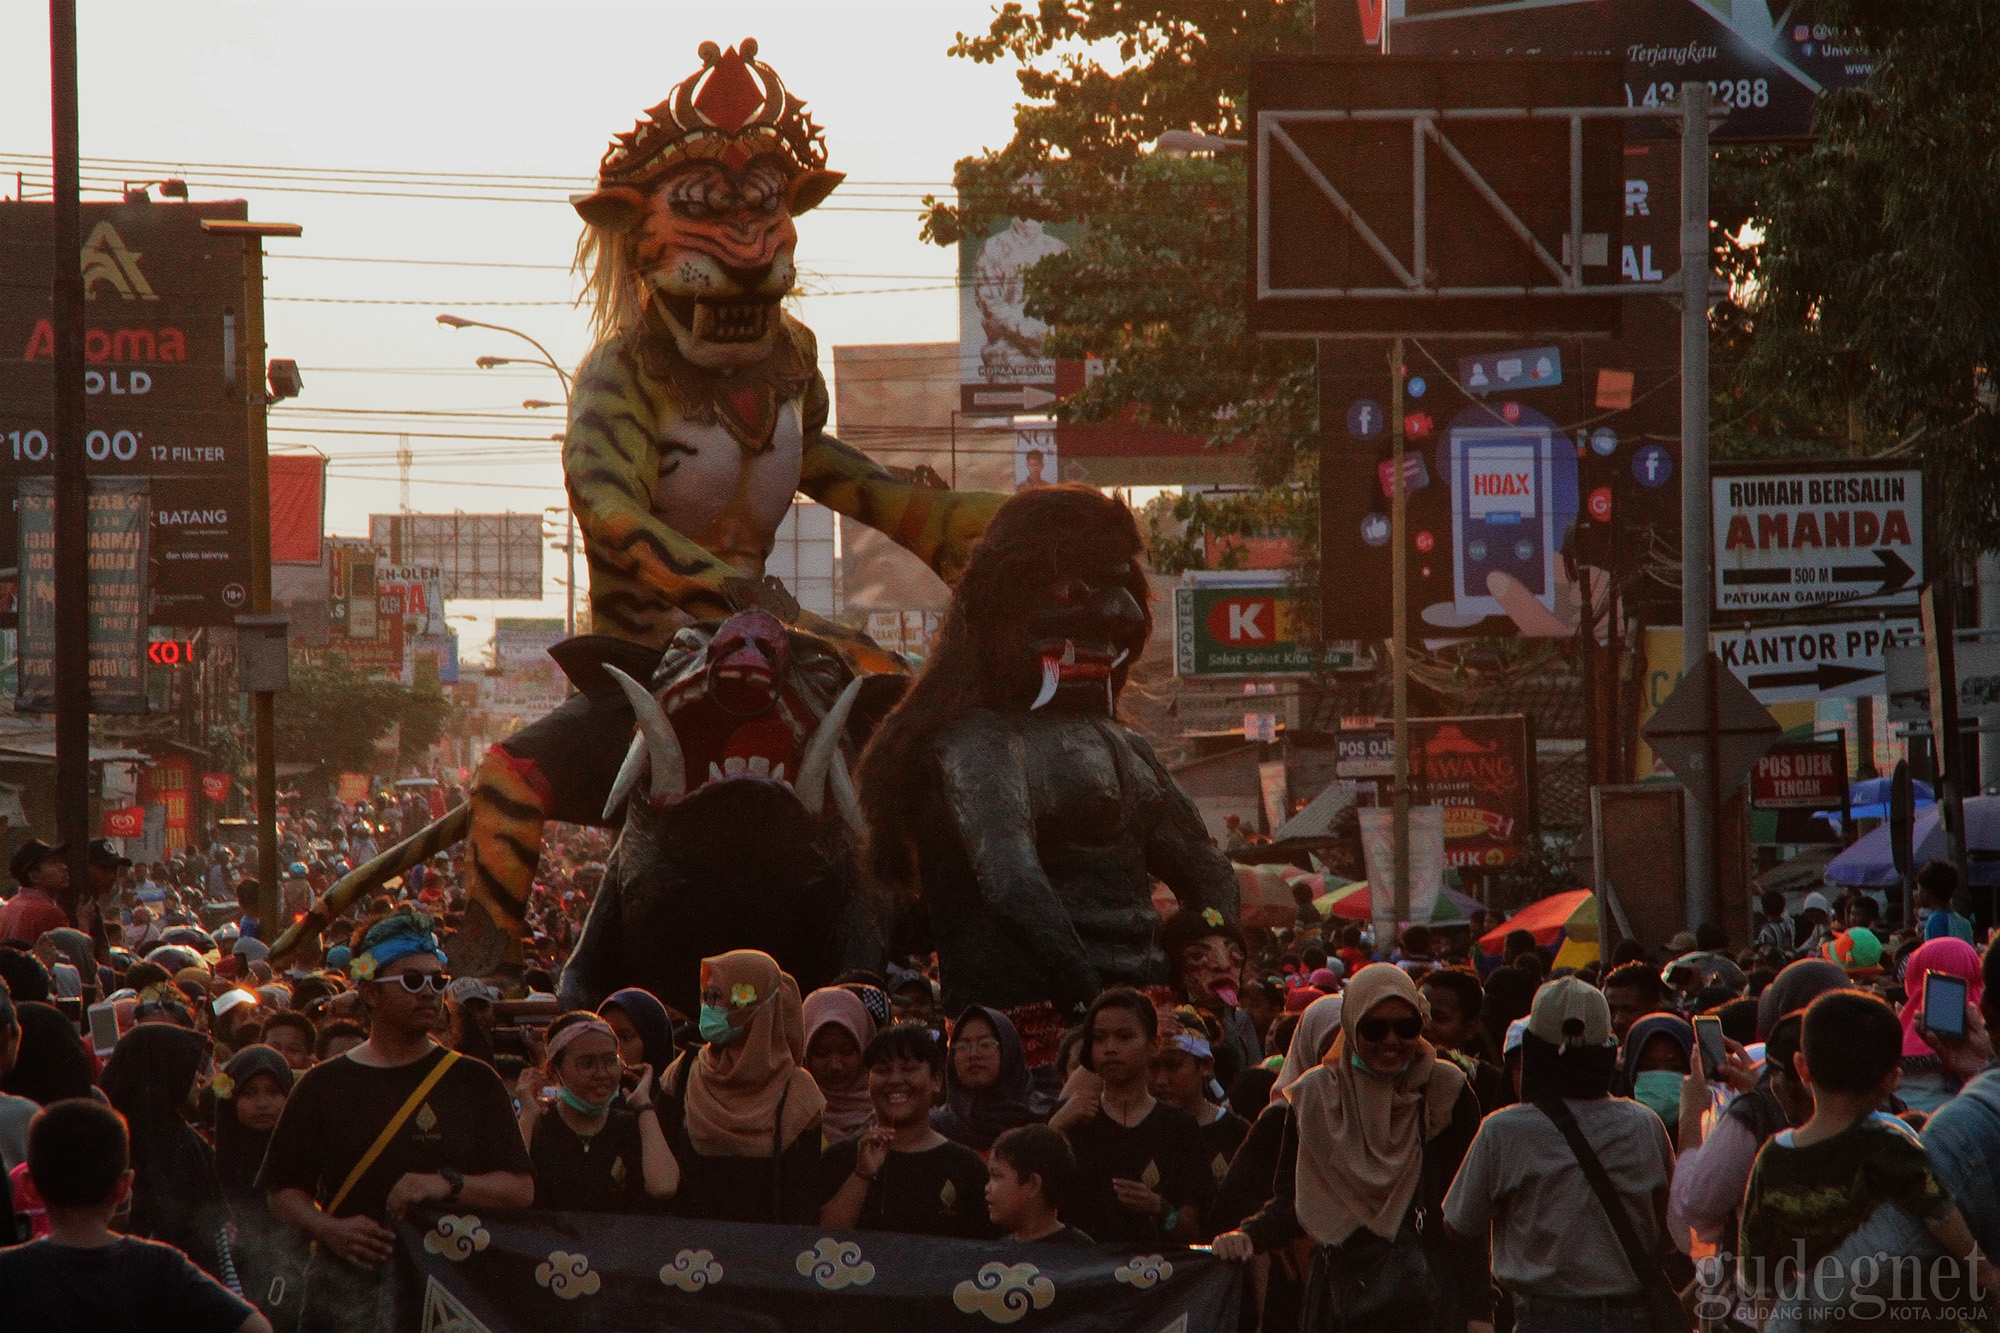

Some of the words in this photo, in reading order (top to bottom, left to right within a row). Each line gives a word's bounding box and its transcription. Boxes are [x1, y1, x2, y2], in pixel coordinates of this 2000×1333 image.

[1626, 40, 1718, 67] Terjangkau
[24, 317, 188, 363] Aoma
[84, 371, 152, 395] OLD
[151, 445, 167, 461] 12
[172, 446, 225, 462] FILTER
[1474, 472, 1531, 496] HOAX
[1730, 481, 1803, 507] RUMAH
[1808, 477, 1906, 504] BERSALIN
[158, 509, 228, 525] BATANG
[1725, 509, 1912, 550] AMANDA
[1795, 568, 1816, 584] 500
[1818, 567, 1829, 583] M
[226, 588, 243, 601] 18+
[1724, 591, 1791, 605] PATUKAN
[1794, 590, 1860, 604] GAMPING
[1179, 590, 1193, 671] APOTEK
[1720, 632, 1837, 667] KANTOR
[1338, 741, 1365, 756] POS
[1369, 739, 1396, 755] OJE
[1759, 755, 1791, 778] POS
[1795, 753, 1834, 776] OJEK
